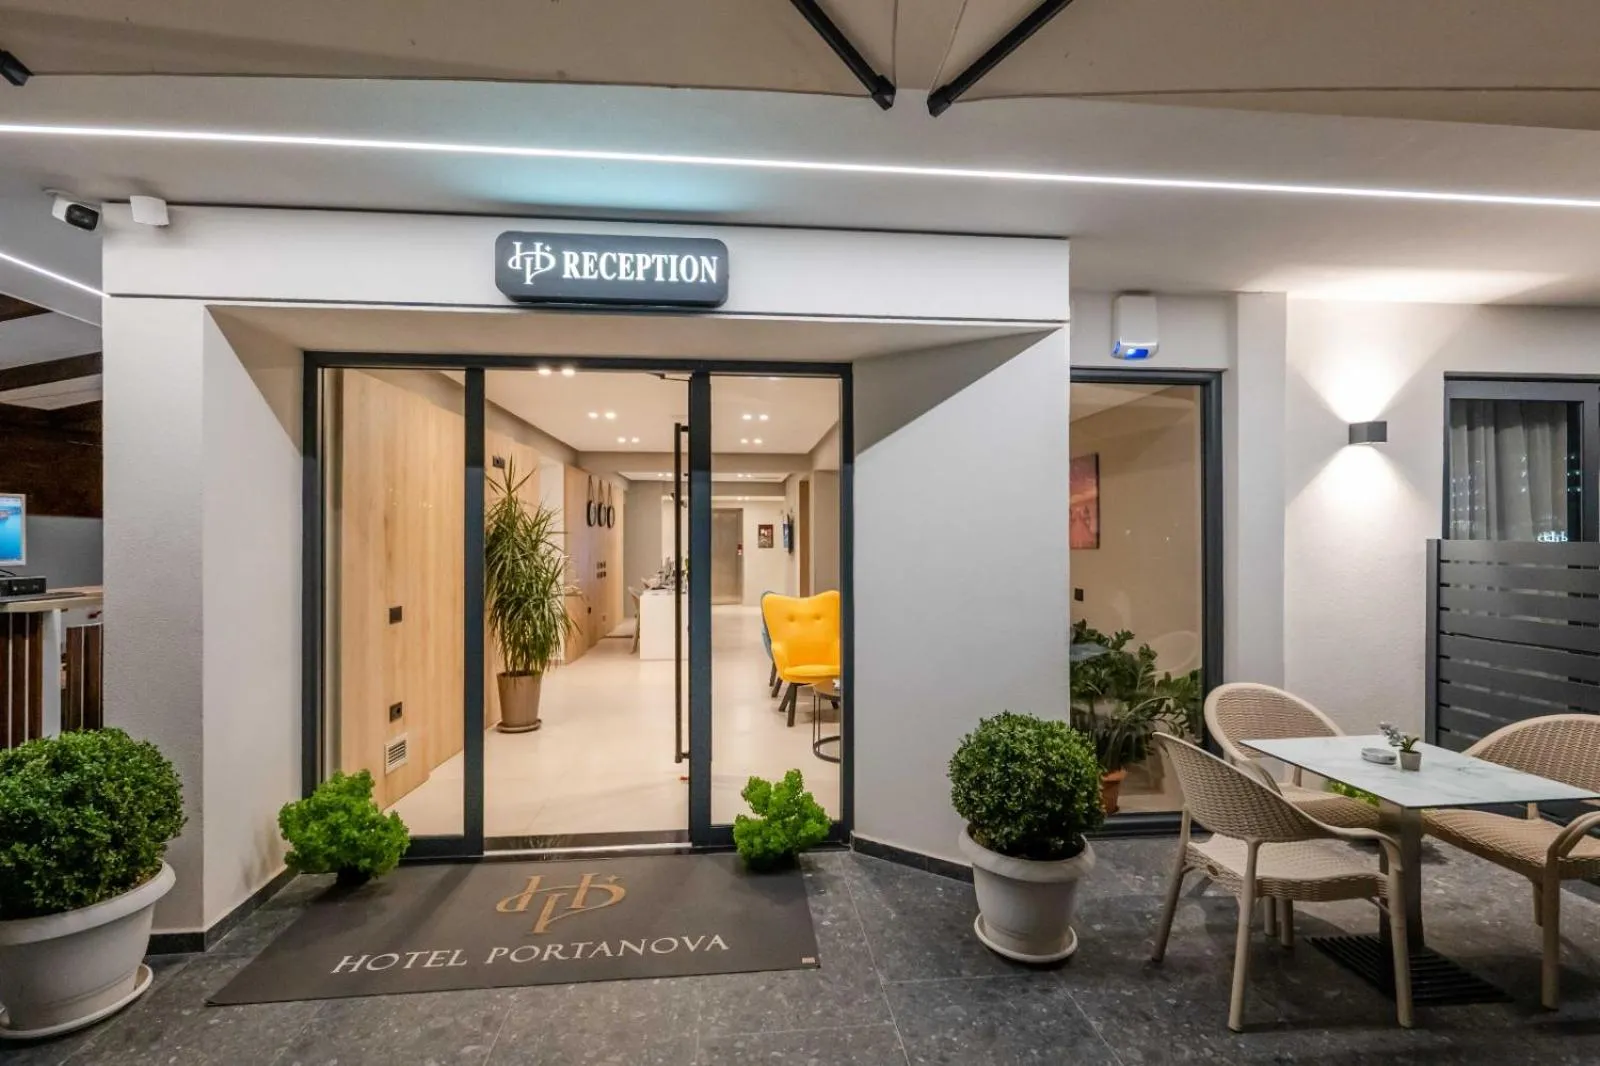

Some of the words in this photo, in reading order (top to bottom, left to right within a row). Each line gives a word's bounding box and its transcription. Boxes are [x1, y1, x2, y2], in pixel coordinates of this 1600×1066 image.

[562, 250, 718, 284] RECEPTION
[330, 949, 468, 974] HOTEL
[484, 934, 729, 964] PORTANOVA
